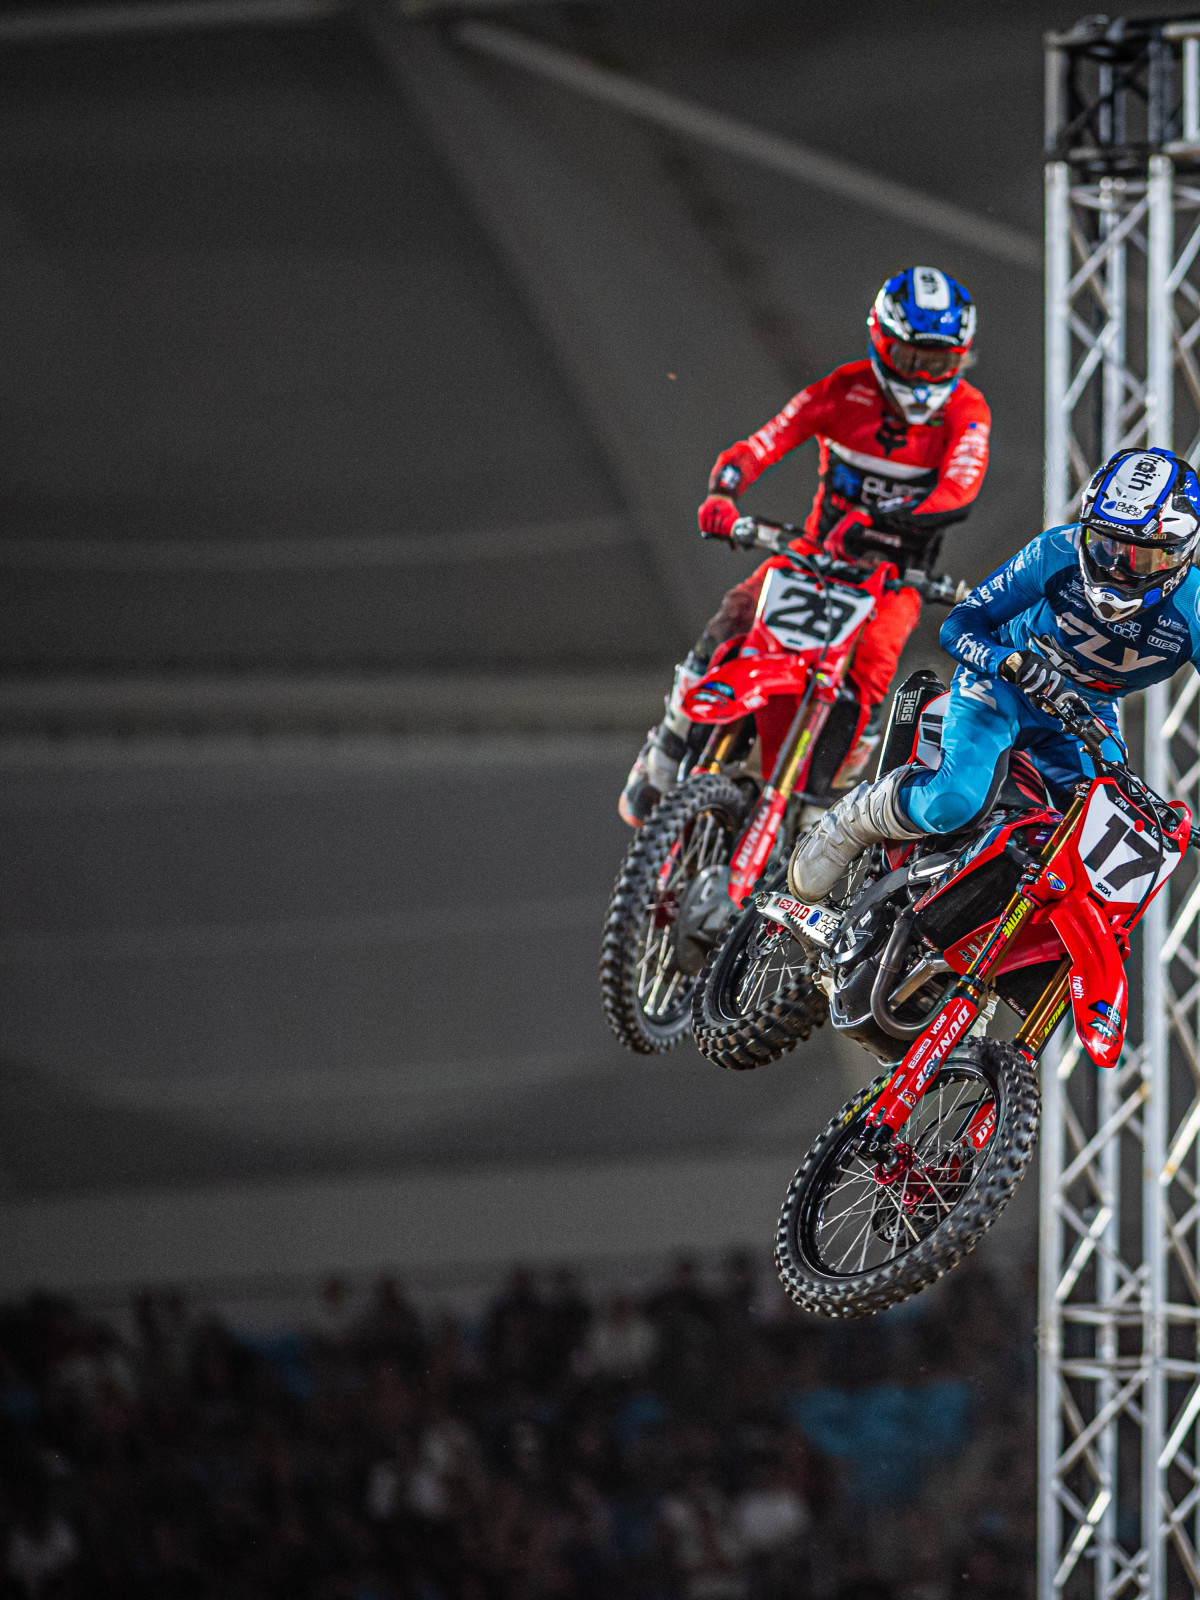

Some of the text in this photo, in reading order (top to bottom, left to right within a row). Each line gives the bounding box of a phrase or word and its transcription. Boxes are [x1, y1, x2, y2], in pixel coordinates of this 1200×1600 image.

[1090, 518, 1136, 535] HONDA
[764, 586, 857, 644] 28
[1148, 635, 1182, 654] WPS
[900, 698, 915, 722] HGS
[1114, 796, 1131, 811] FIM
[736, 805, 770, 870] DUNLO
[1082, 813, 1167, 892] 17
[815, 921, 833, 937] LOC
[821, 914, 840, 929] QUA
[1002, 899, 1029, 940] ACTIVE
[1043, 999, 1066, 1038] ACTIVE
[915, 1004, 971, 1093] DUNLOP
[843, 1077, 891, 1125] DUNLO
